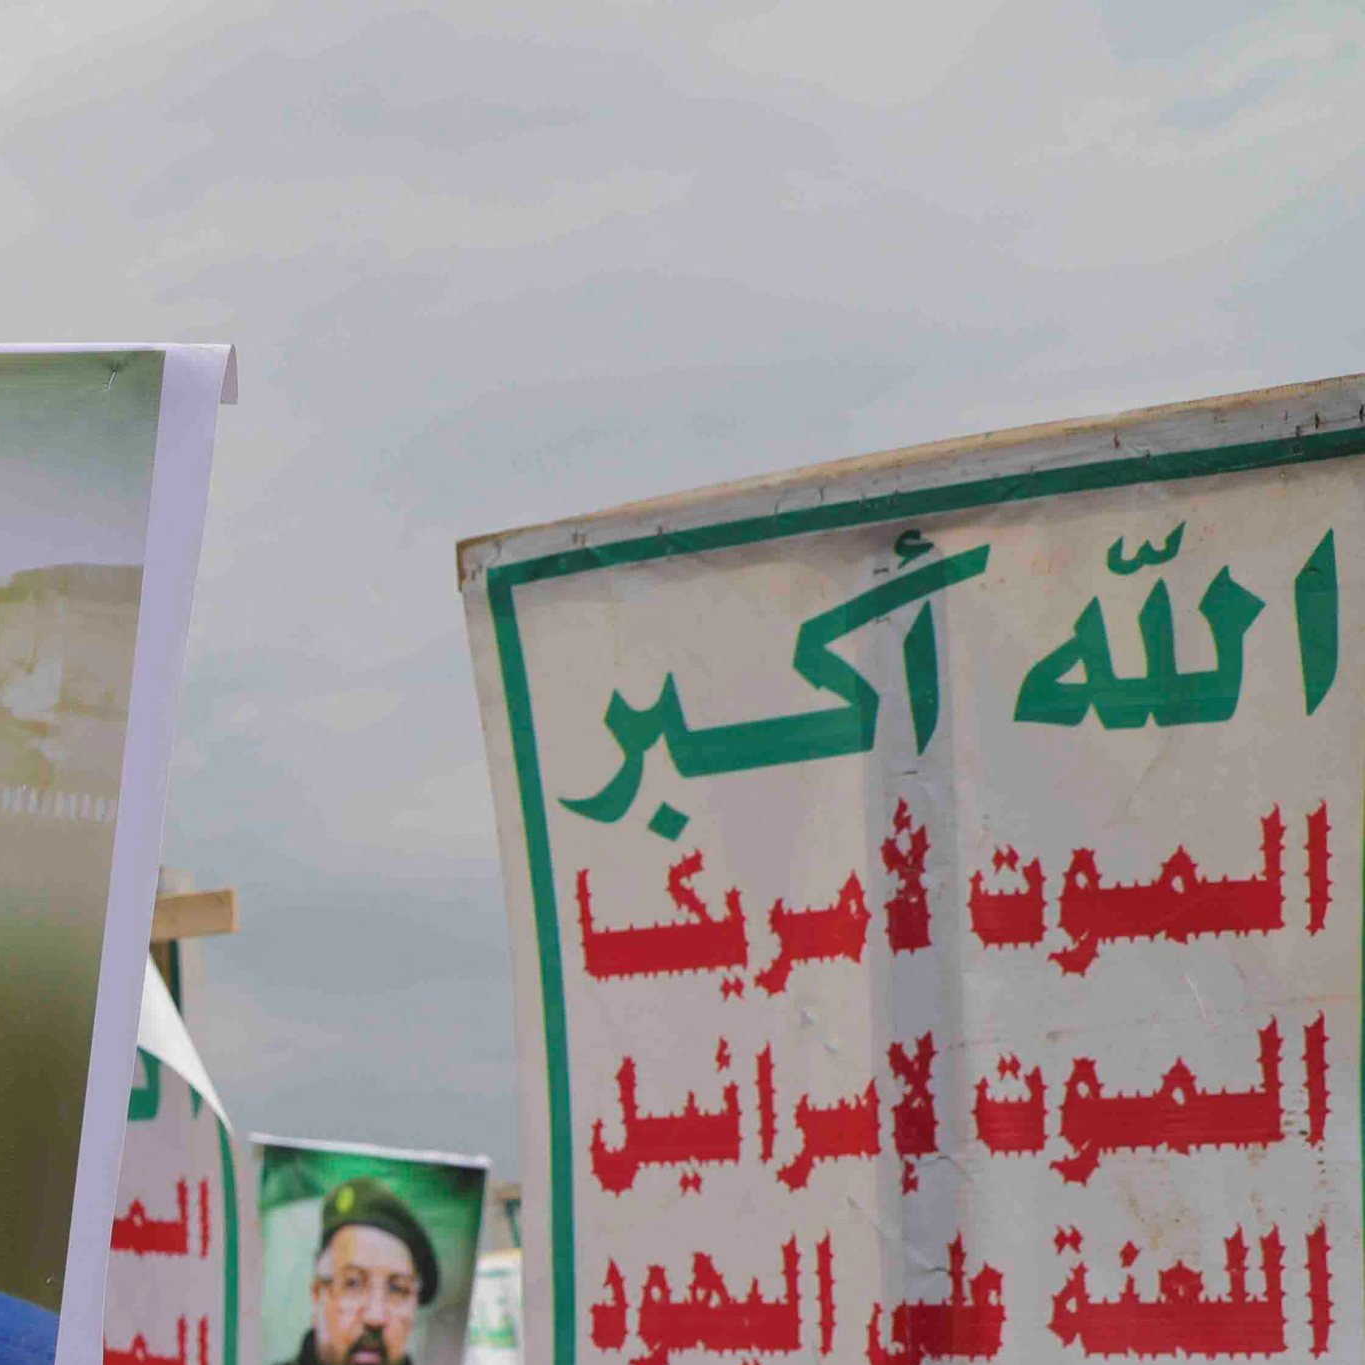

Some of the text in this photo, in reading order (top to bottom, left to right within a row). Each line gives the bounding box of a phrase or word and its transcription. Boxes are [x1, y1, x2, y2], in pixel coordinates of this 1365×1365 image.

[557, 529, 990, 842] أكبر
[576, 797, 1334, 999] الموت لأمريكا
[589, 1009, 1332, 1198] الموت لإسرائيل
[111, 1177, 210, 1259] الم
[1047, 1218, 1334, 1360] اللعنة
